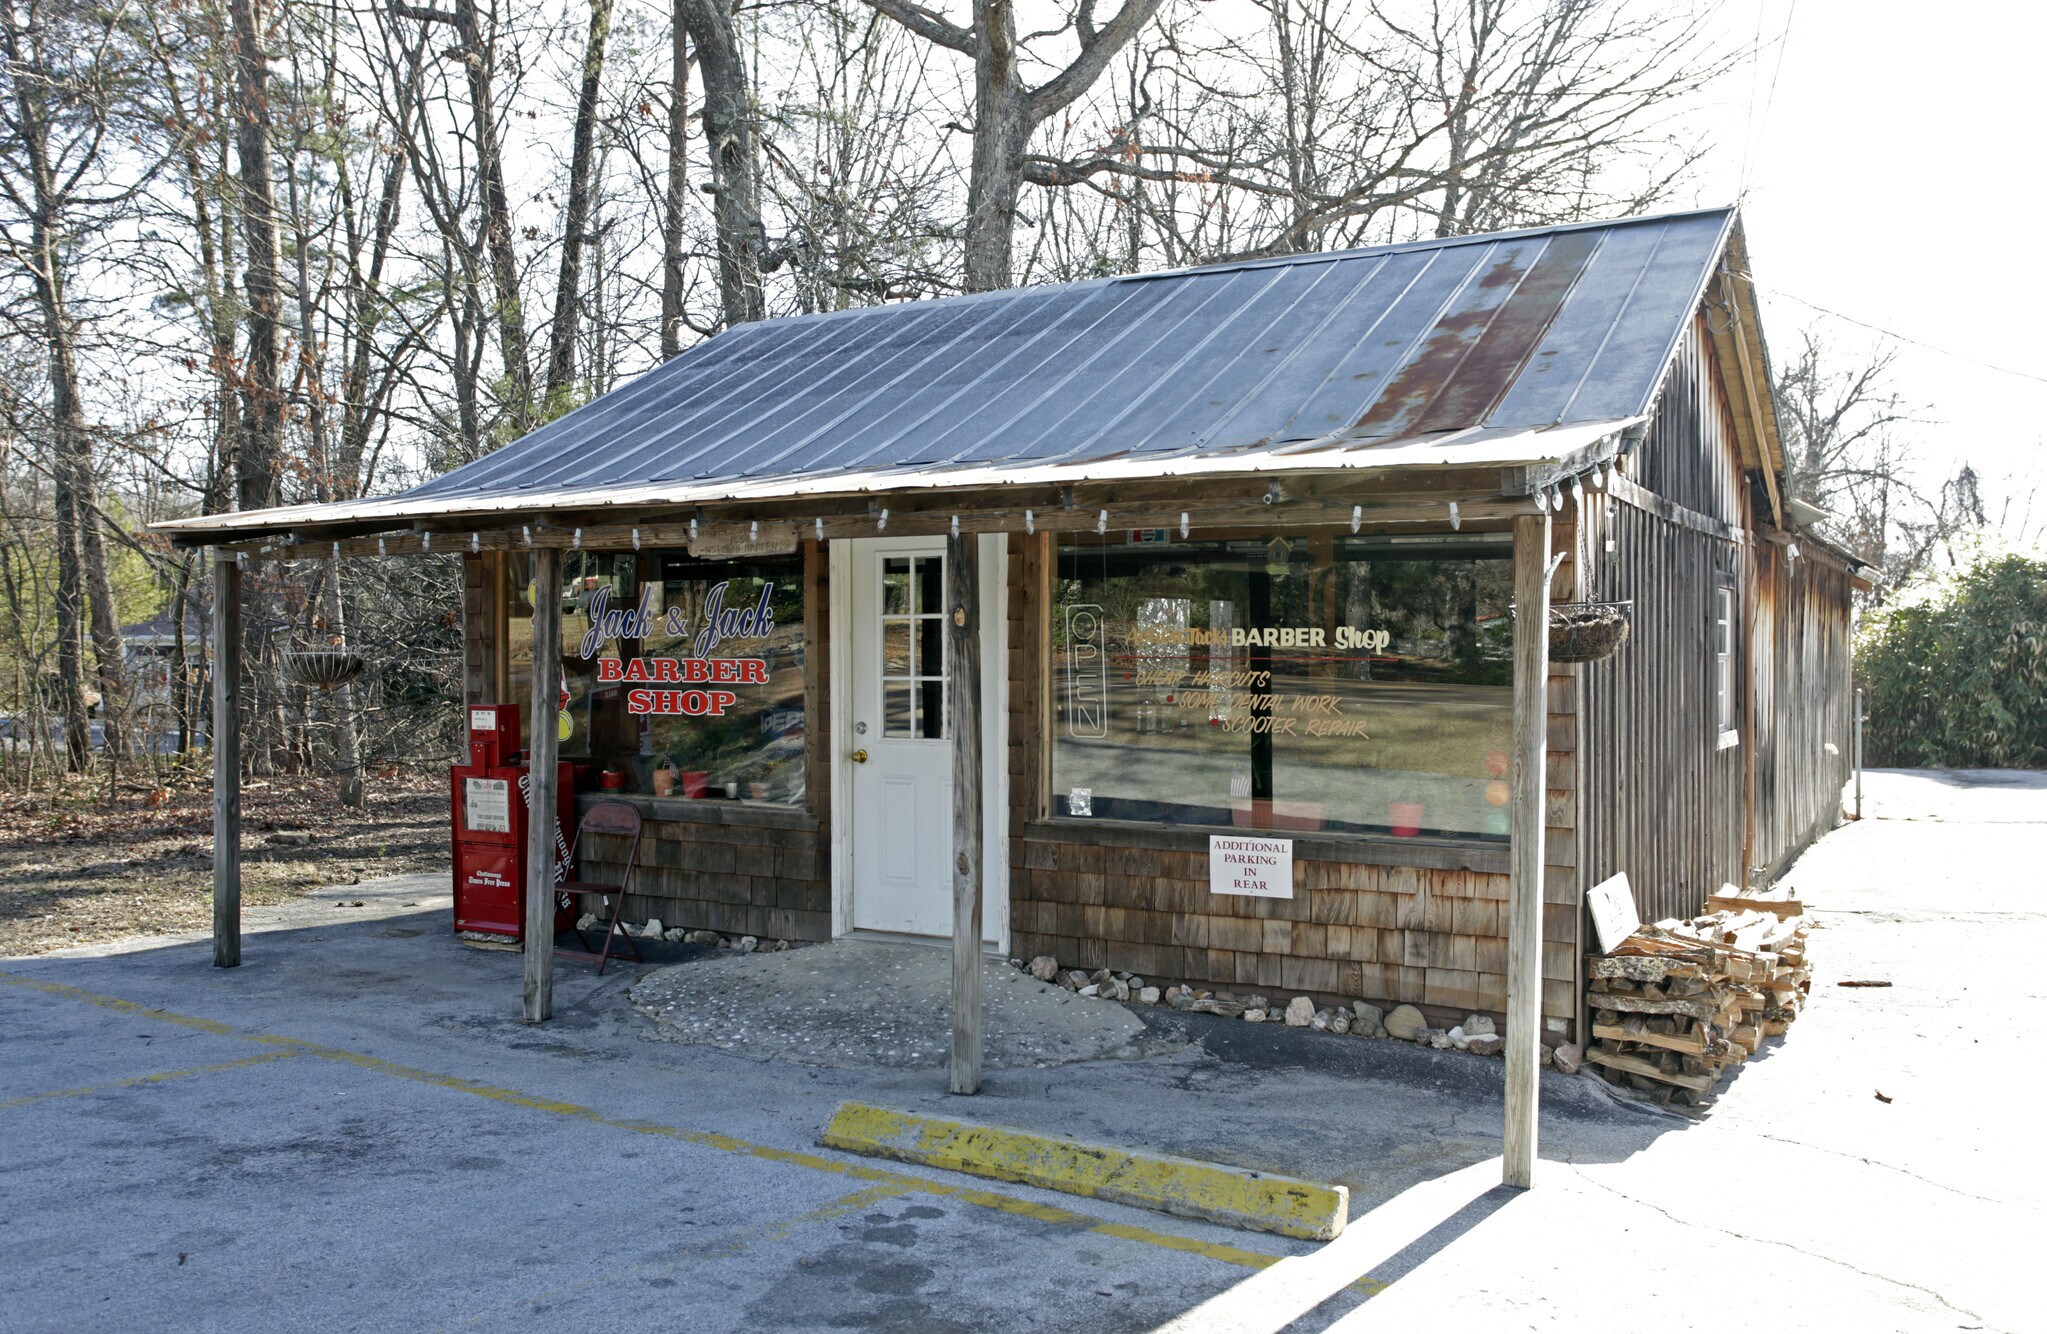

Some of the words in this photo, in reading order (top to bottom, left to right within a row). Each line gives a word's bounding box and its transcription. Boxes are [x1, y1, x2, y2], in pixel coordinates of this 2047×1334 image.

[581, 583, 654, 660] Jack
[665, 605, 689, 637] &
[694, 581, 775, 660] Jack
[1232, 627, 1327, 647] BARBER
[1334, 626, 1390, 655] Shop
[597, 657, 770, 684] BARBER
[1072, 611, 1100, 731] OPEN
[1135, 670, 1186, 687] CHEAP
[1191, 670, 1271, 688] HAIRCUTS
[628, 689, 736, 716] SHOP
[1178, 691, 1221, 710] SOME
[1226, 692, 1284, 712] DENTAL
[1291, 694, 1344, 715] WORK
[1222, 716, 1298, 738] SCOOTER
[1305, 719, 1370, 740] REPAIR
[1213, 840, 1288, 854] ADDITIONAL
[1224, 853, 1277, 866] PARKING
[468, 875, 483, 885] Times
[483, 877, 495, 886] Free
[495, 878, 511, 888] Press
[1244, 867, 1257, 877] IN
[1233, 879, 1268, 890] REAR
